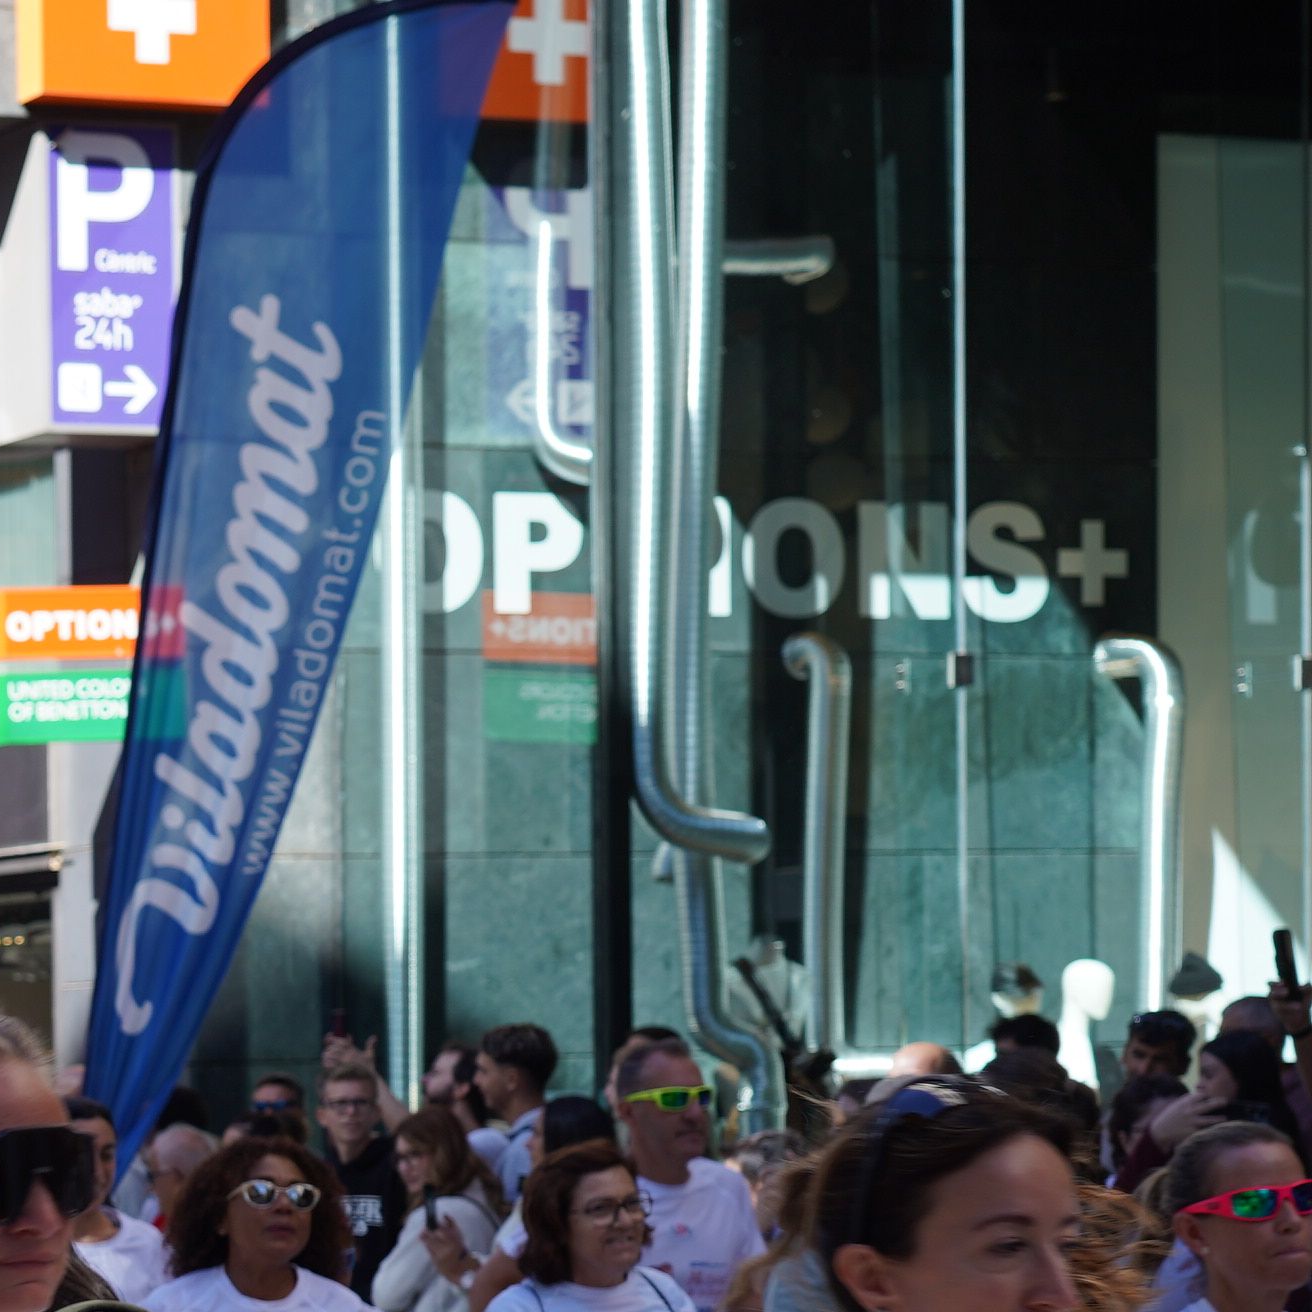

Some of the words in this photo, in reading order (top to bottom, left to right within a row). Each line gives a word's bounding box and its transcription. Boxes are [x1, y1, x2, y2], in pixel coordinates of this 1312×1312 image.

[56, 131, 155, 273] P
[74, 315, 134, 351] 24h
[115, 293, 343, 1036] Viladomat
[240, 409, 389, 877] www.viladomat.com
